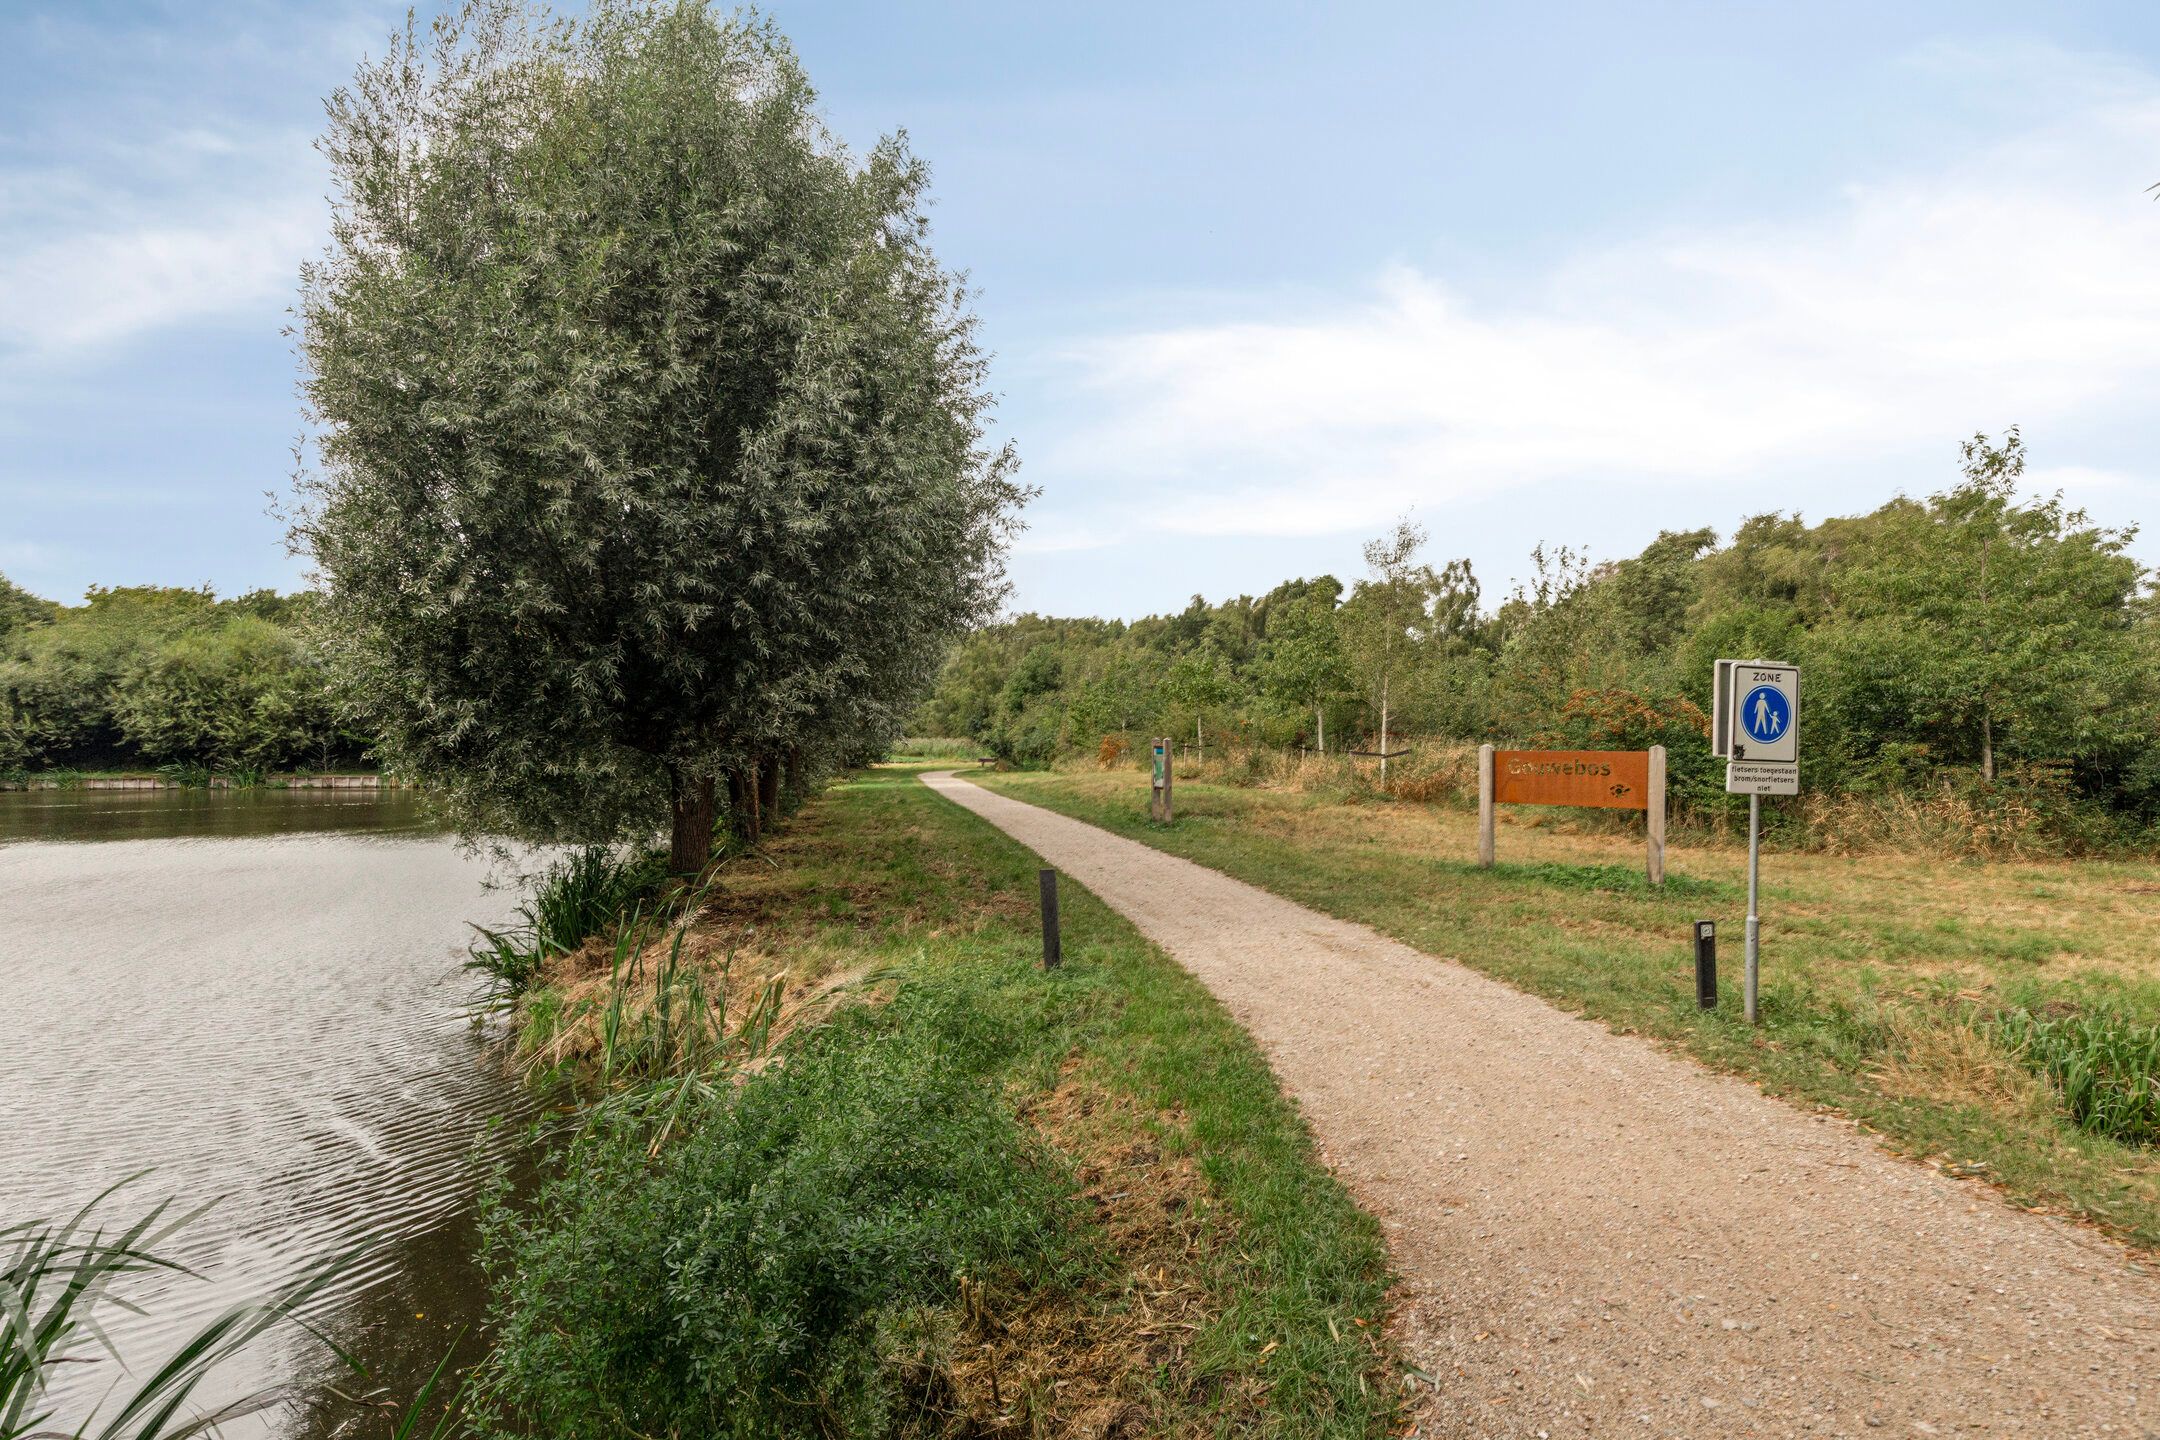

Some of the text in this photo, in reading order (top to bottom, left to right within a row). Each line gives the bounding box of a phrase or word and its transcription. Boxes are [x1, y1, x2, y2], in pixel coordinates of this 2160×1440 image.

[1753, 672, 1782, 683] ZONE
[1507, 758, 1611, 777] Gouwebos
[1731, 766, 1797, 776] fietsers toegestaan
[1733, 775, 1795, 784] brom/snorfietsers
